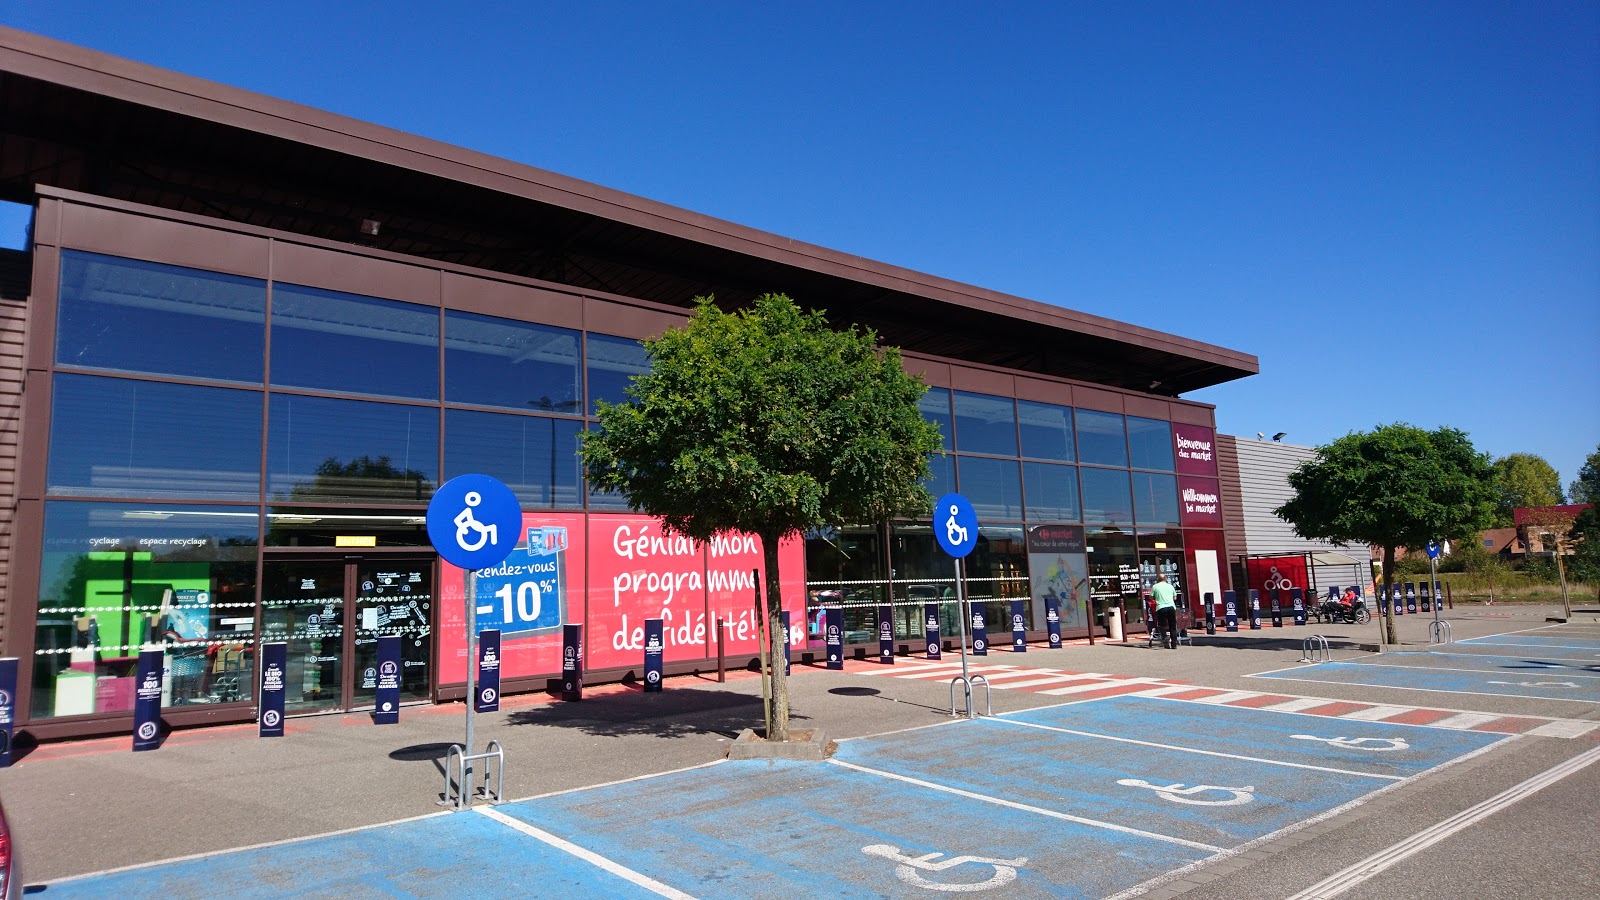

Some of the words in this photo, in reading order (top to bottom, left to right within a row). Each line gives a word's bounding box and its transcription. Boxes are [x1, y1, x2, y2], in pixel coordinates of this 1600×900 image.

[1176, 433, 1211, 451] bienvenue
[1178, 449, 1190, 459] chez
[1190, 451, 1211, 461] market
[1182, 488, 1218, 503] Willkommen
[1186, 503, 1194, 513] bei
[1195, 504, 1216, 514] market
[1050, 530, 1073, 539] market
[139, 538, 167, 546] espace
[169, 537, 207, 546] recyclage
[710, 535, 758, 558] mon
[613, 614, 644, 651] de
[143, 681, 158, 690] 100
